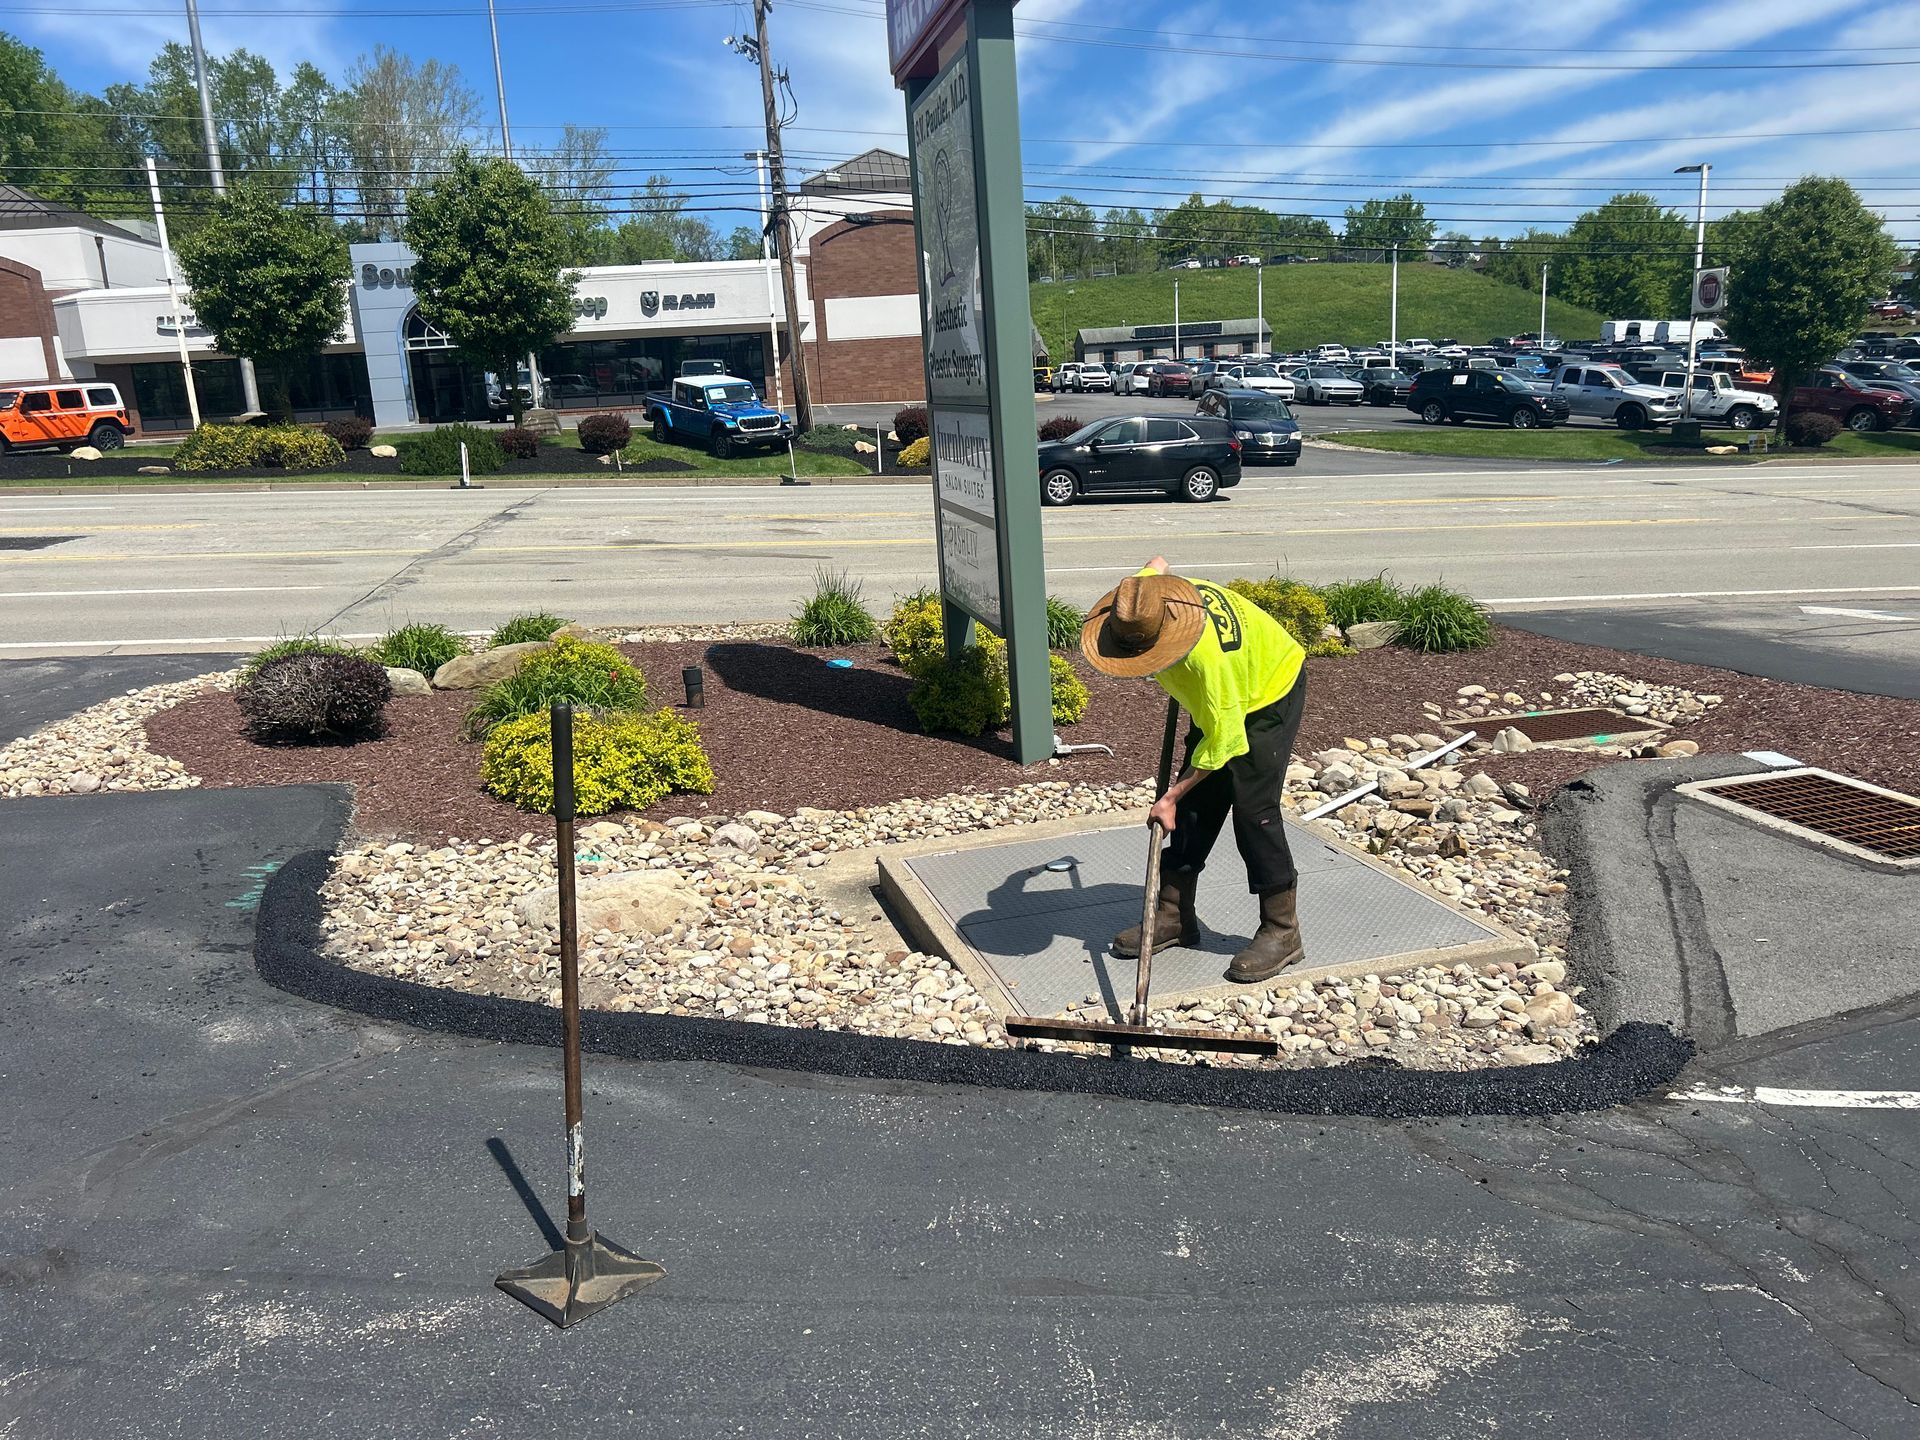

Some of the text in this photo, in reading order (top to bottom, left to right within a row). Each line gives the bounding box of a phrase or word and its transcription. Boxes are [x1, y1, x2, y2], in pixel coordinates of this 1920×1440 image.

[950, 73, 967, 113] M.D.
[571, 296, 607, 316] eep
[663, 293, 715, 309] RAM
[935, 296, 968, 333] Aesthetic
[929, 349, 982, 386] Plastic Surgery
[937, 420, 988, 480] turnberry
[945, 474, 985, 499] SALON SUITES
